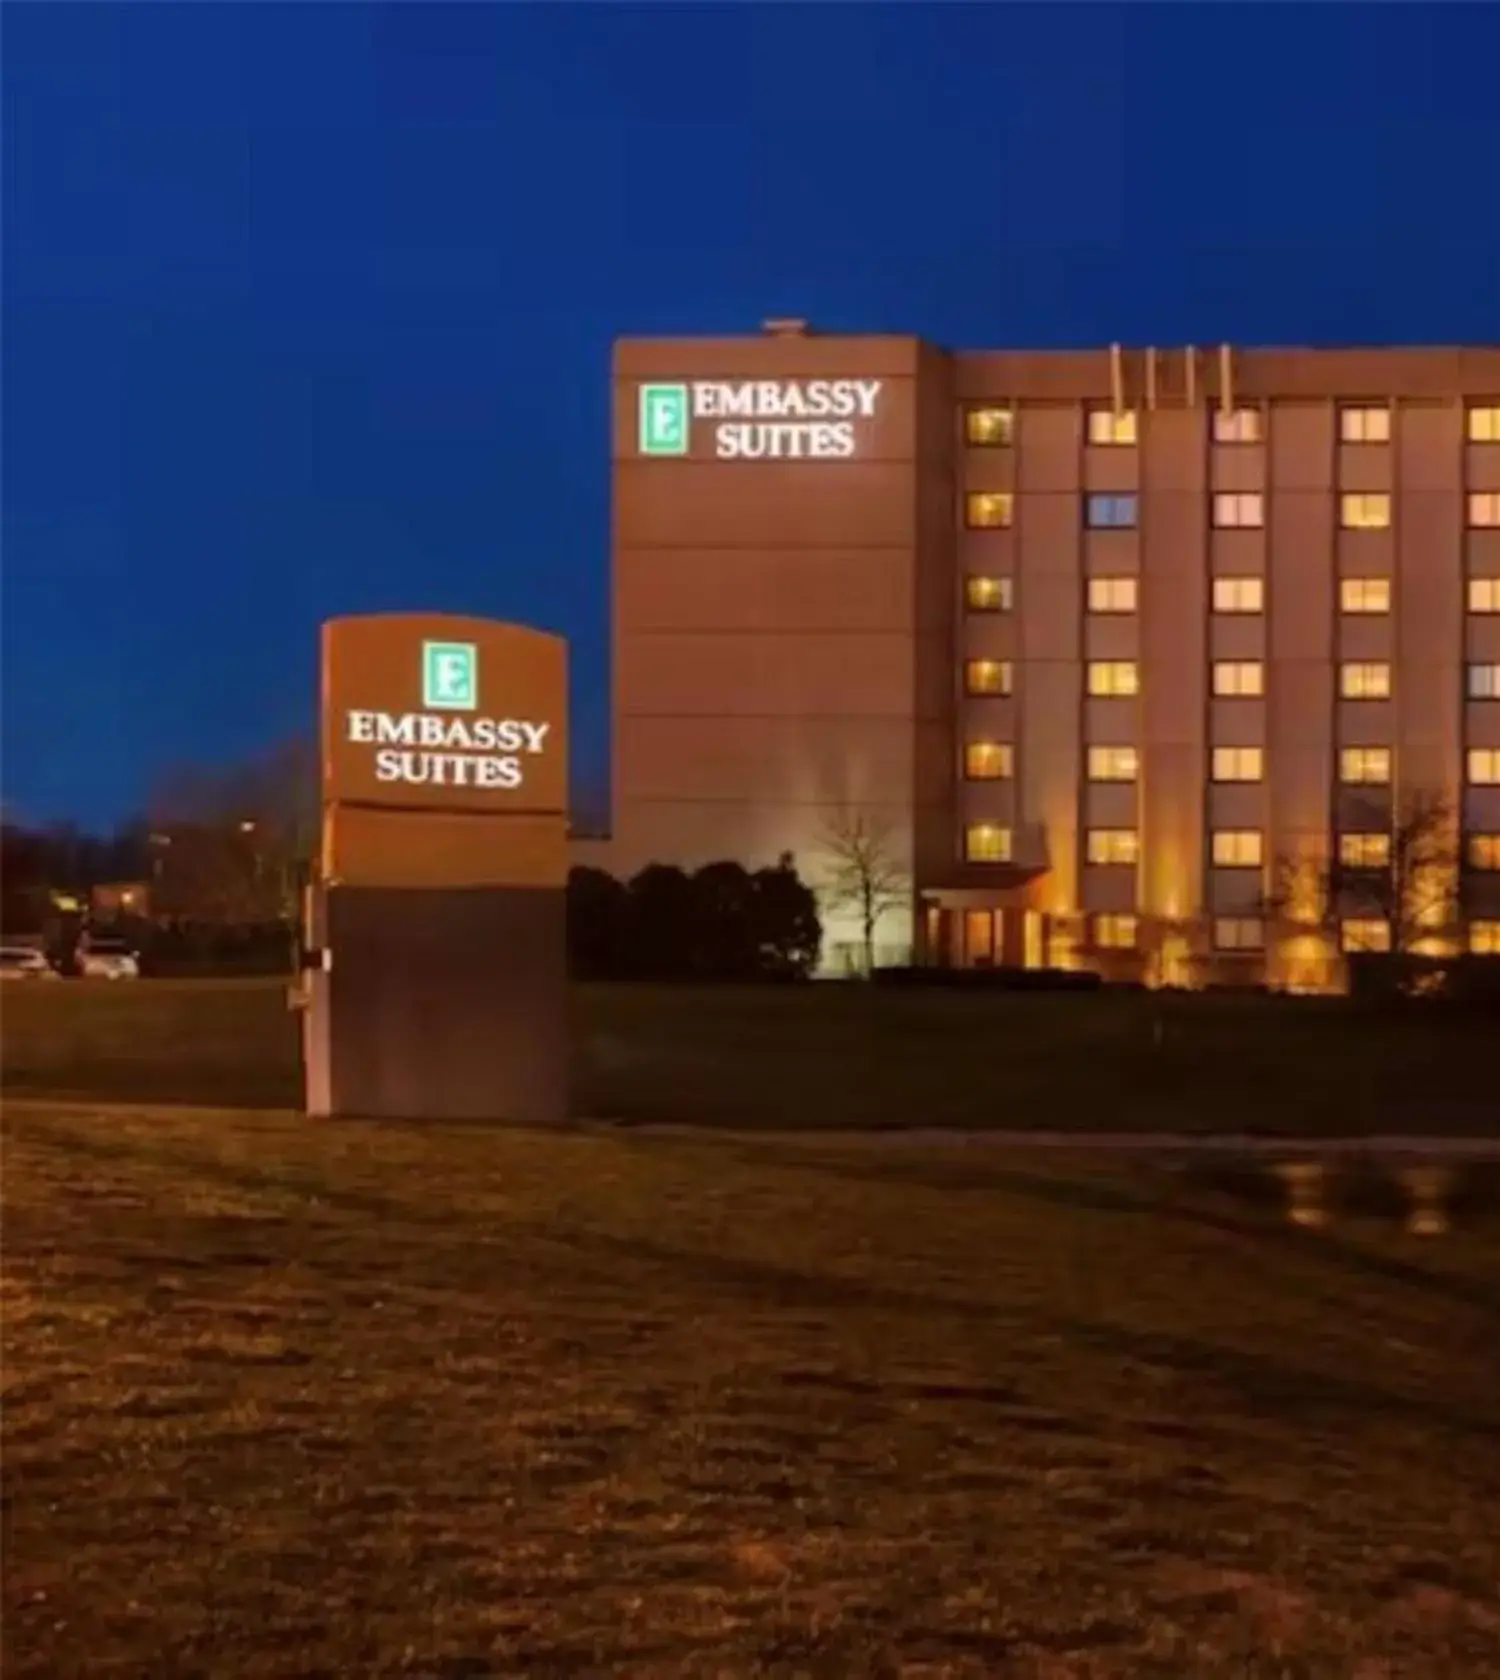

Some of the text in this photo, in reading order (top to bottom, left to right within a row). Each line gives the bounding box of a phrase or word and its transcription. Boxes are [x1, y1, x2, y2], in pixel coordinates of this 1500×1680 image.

[693, 380, 881, 417] EMBASSY
[716, 422, 855, 457] SUITES
[348, 710, 549, 754] EMBASSY
[376, 749, 522, 788] SUITES
